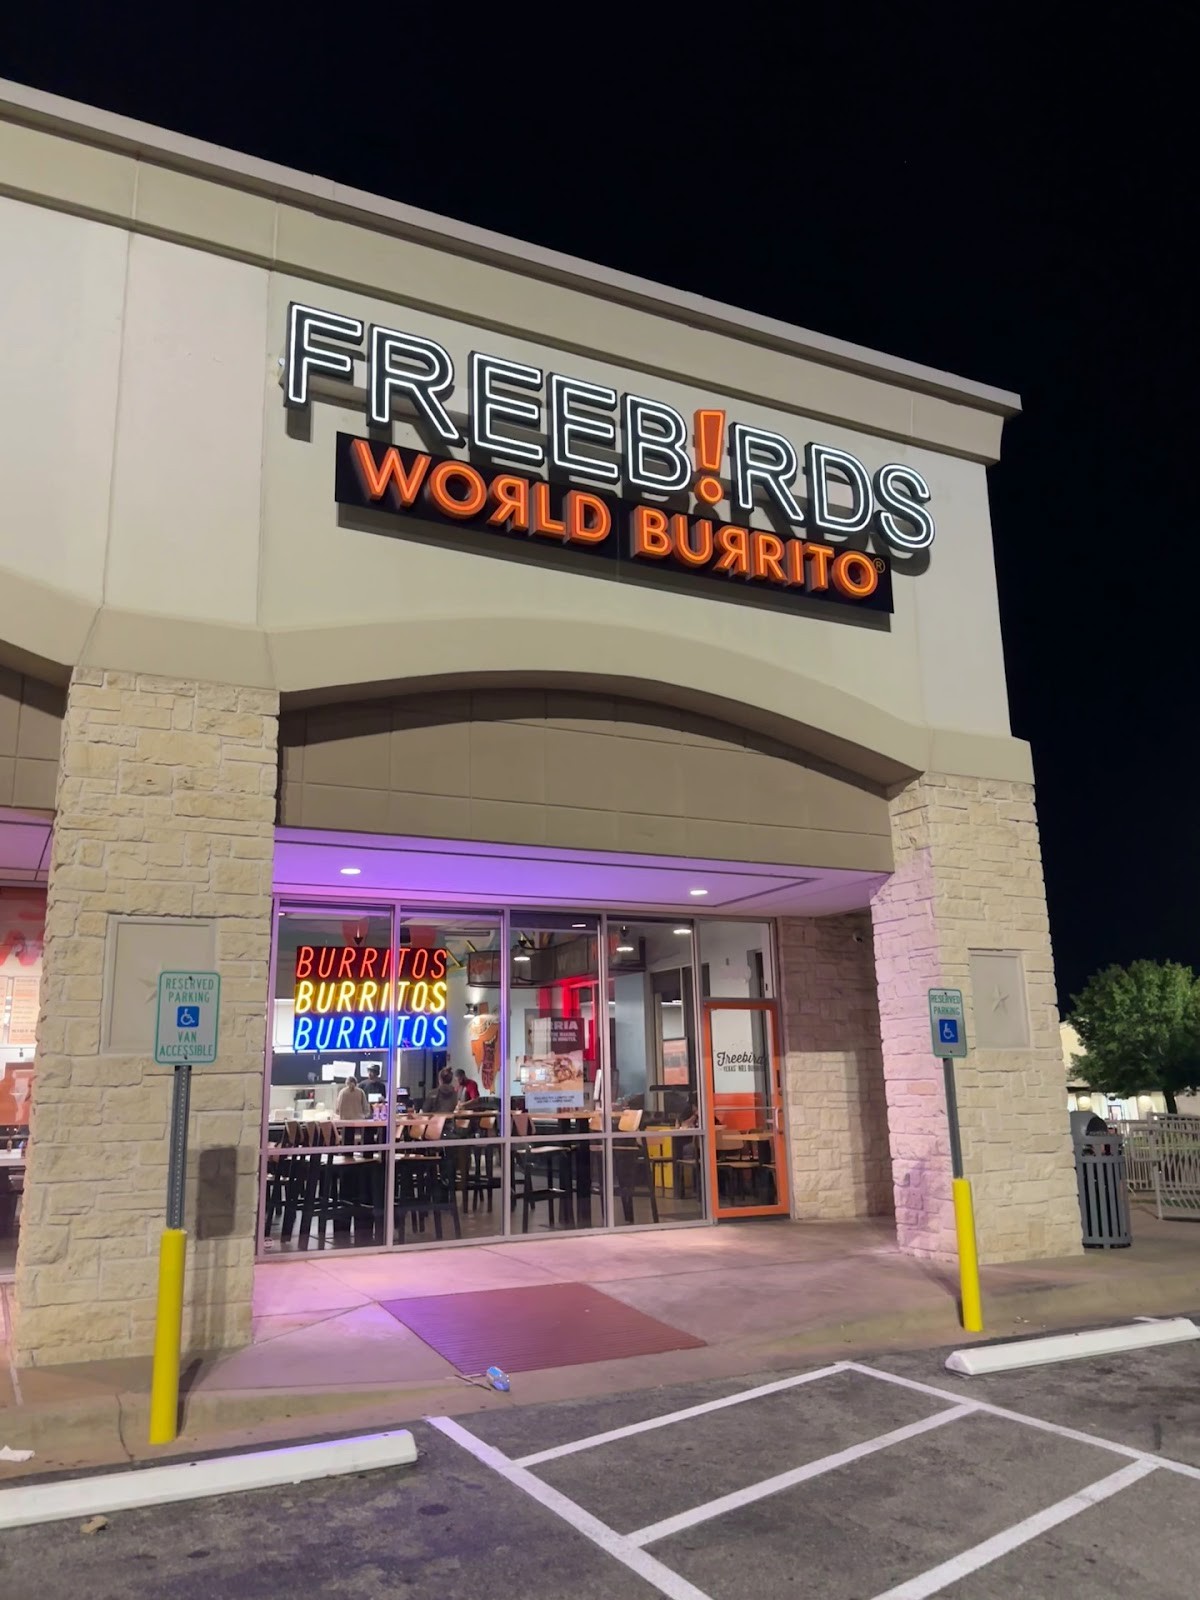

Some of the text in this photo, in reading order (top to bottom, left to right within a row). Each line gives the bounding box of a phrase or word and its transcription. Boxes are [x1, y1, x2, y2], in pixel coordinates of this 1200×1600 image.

[286, 301, 936, 549] FREEB!RDS
[296, 946, 448, 979] BURRITOS
[165, 977, 214, 990] RESERVED
[168, 991, 210, 1003] PARKING
[295, 980, 448, 1014] BURRITOS
[930, 995, 961, 1004] RESERVED
[933, 1006, 961, 1016] PARKING
[177, 1031, 197, 1043] VAN
[294, 1015, 448, 1050] BURRITOS
[159, 1044, 214, 1057] ACCESSIBLE
